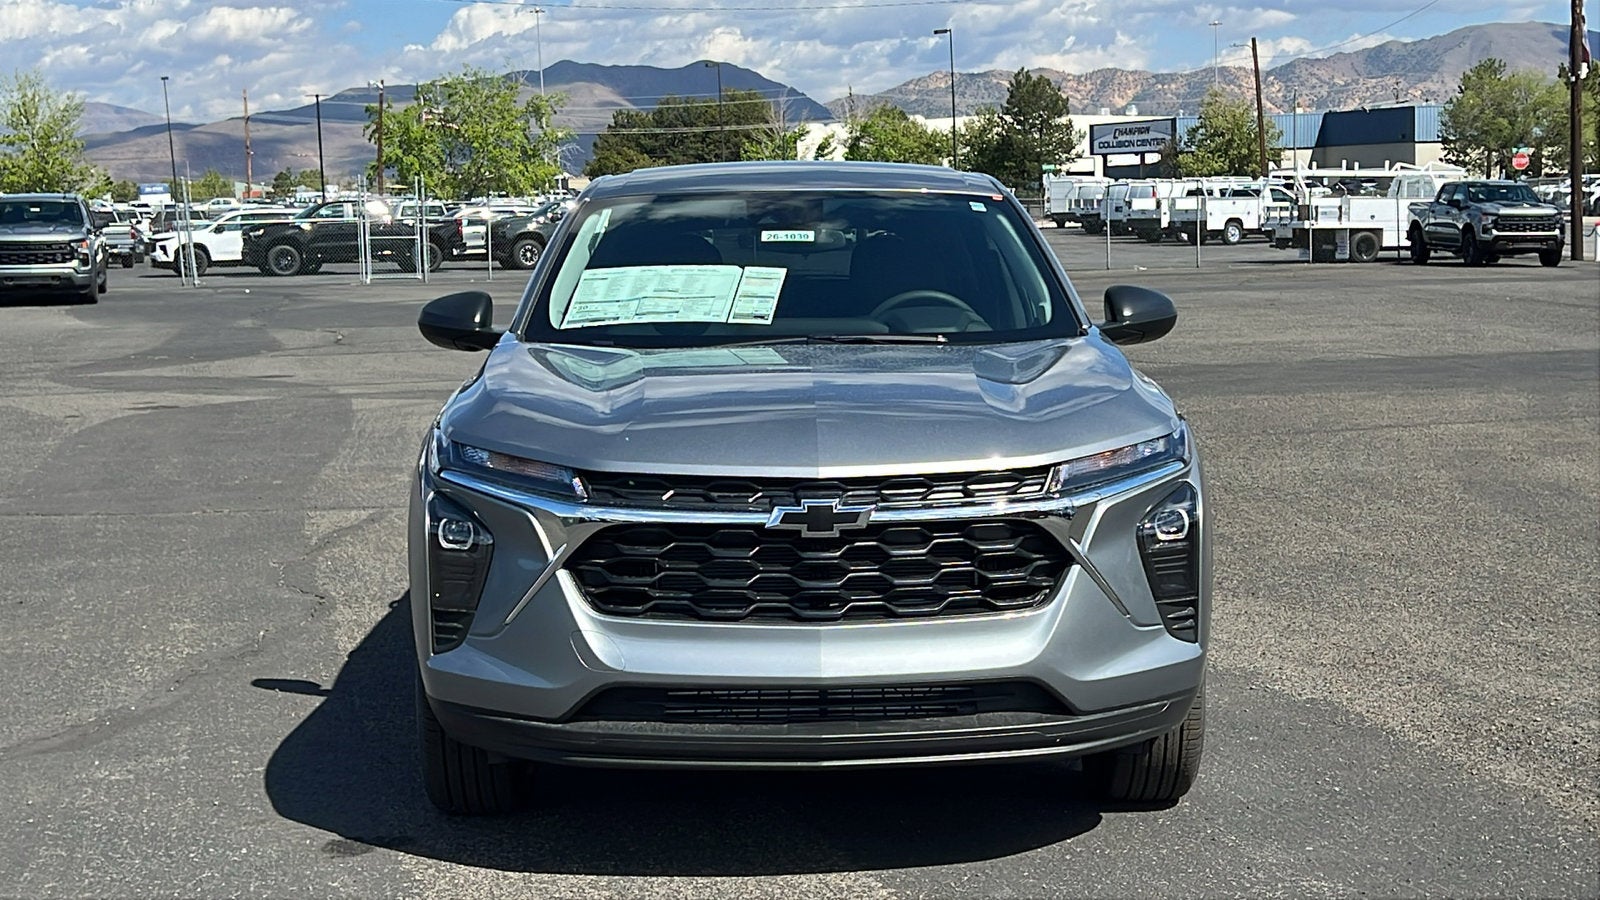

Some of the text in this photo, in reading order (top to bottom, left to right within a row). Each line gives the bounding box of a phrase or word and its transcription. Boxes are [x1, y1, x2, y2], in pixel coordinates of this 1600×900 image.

[1113, 126, 1151, 139] CHAMPION
[1098, 137, 1166, 149] COLLISION CENTER
